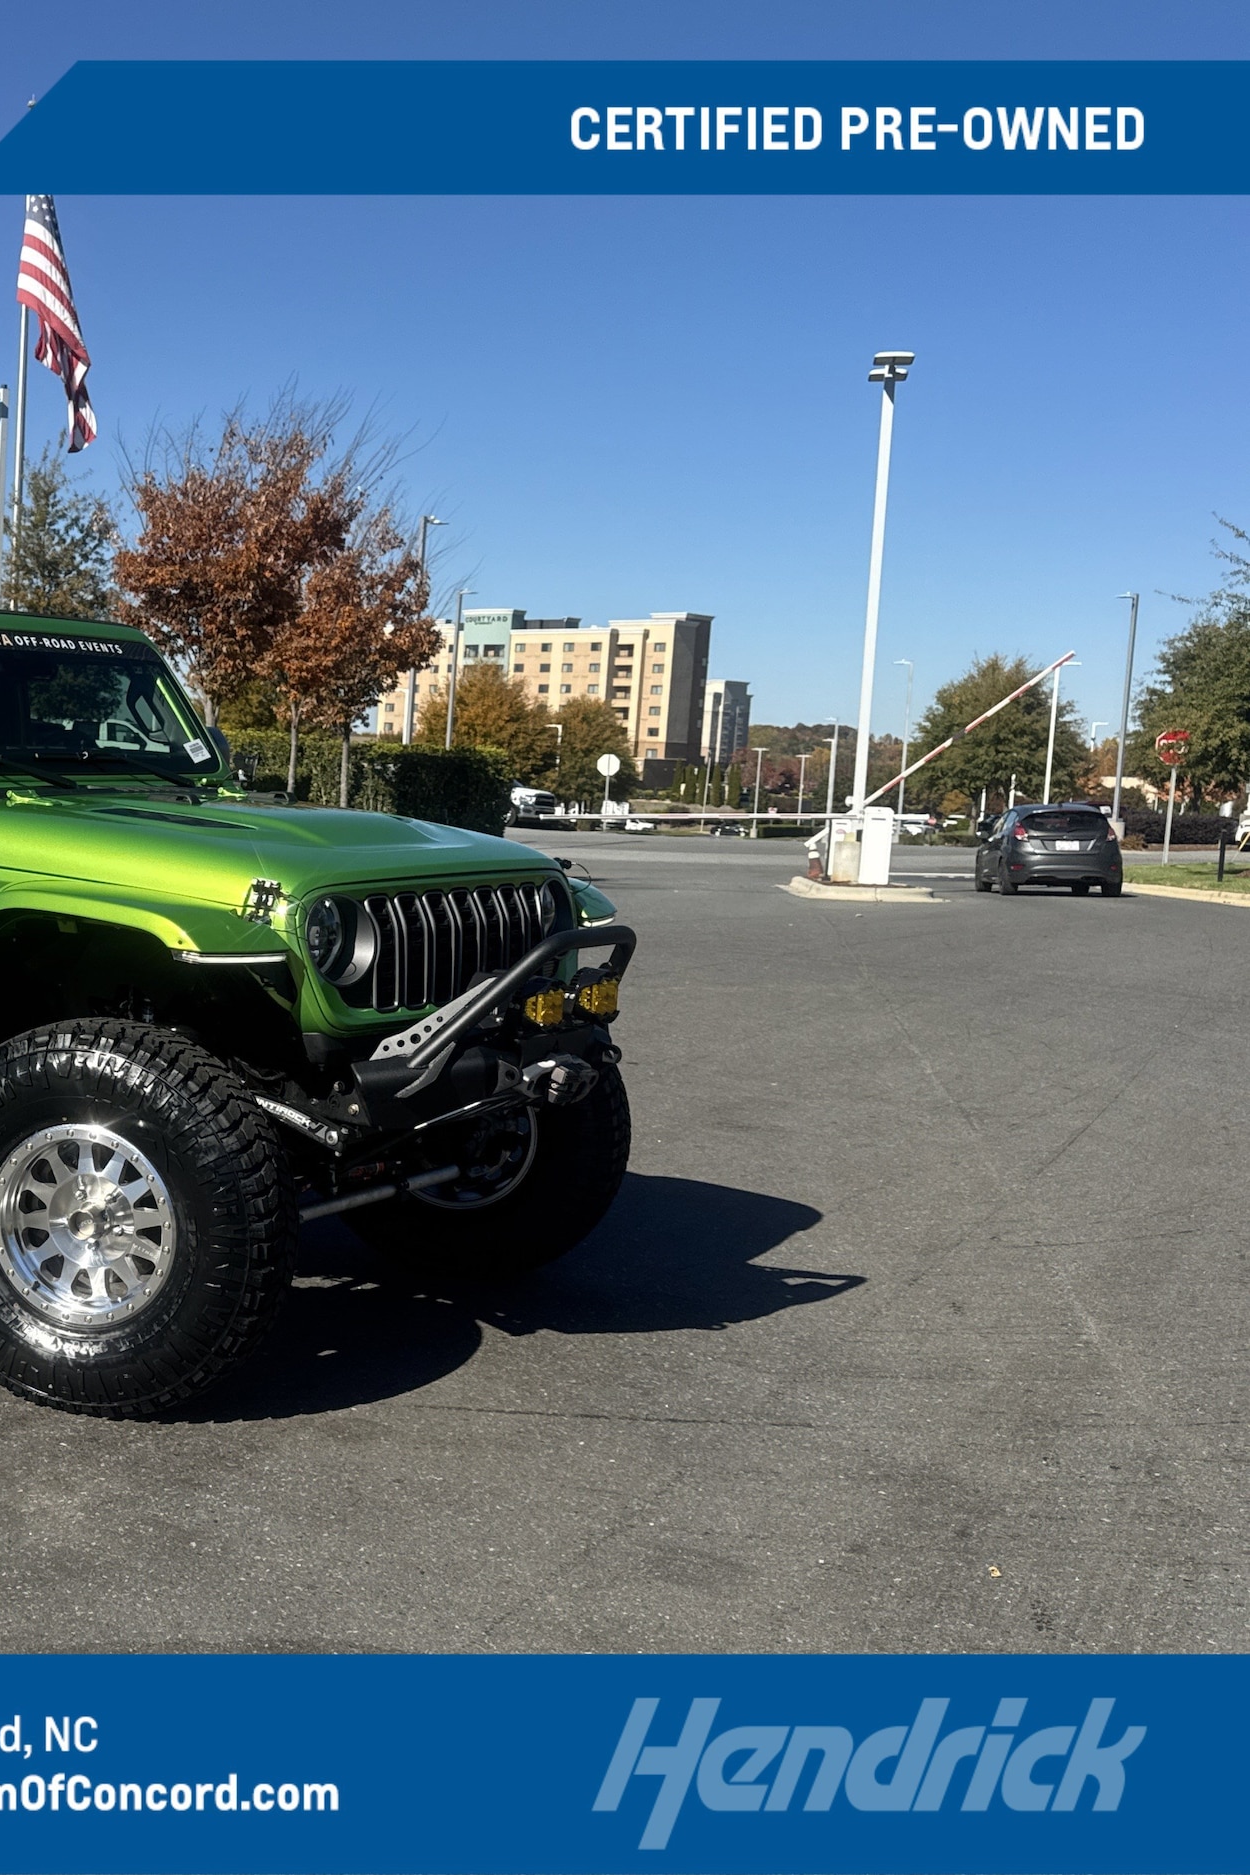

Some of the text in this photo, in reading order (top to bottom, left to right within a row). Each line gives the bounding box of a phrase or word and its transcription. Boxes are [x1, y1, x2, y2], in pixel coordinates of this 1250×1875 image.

[465, 615, 508, 623] COURTYARD
[14, 635, 76, 650] OFF-ROAD
[79, 640, 123, 655] EVENTS
